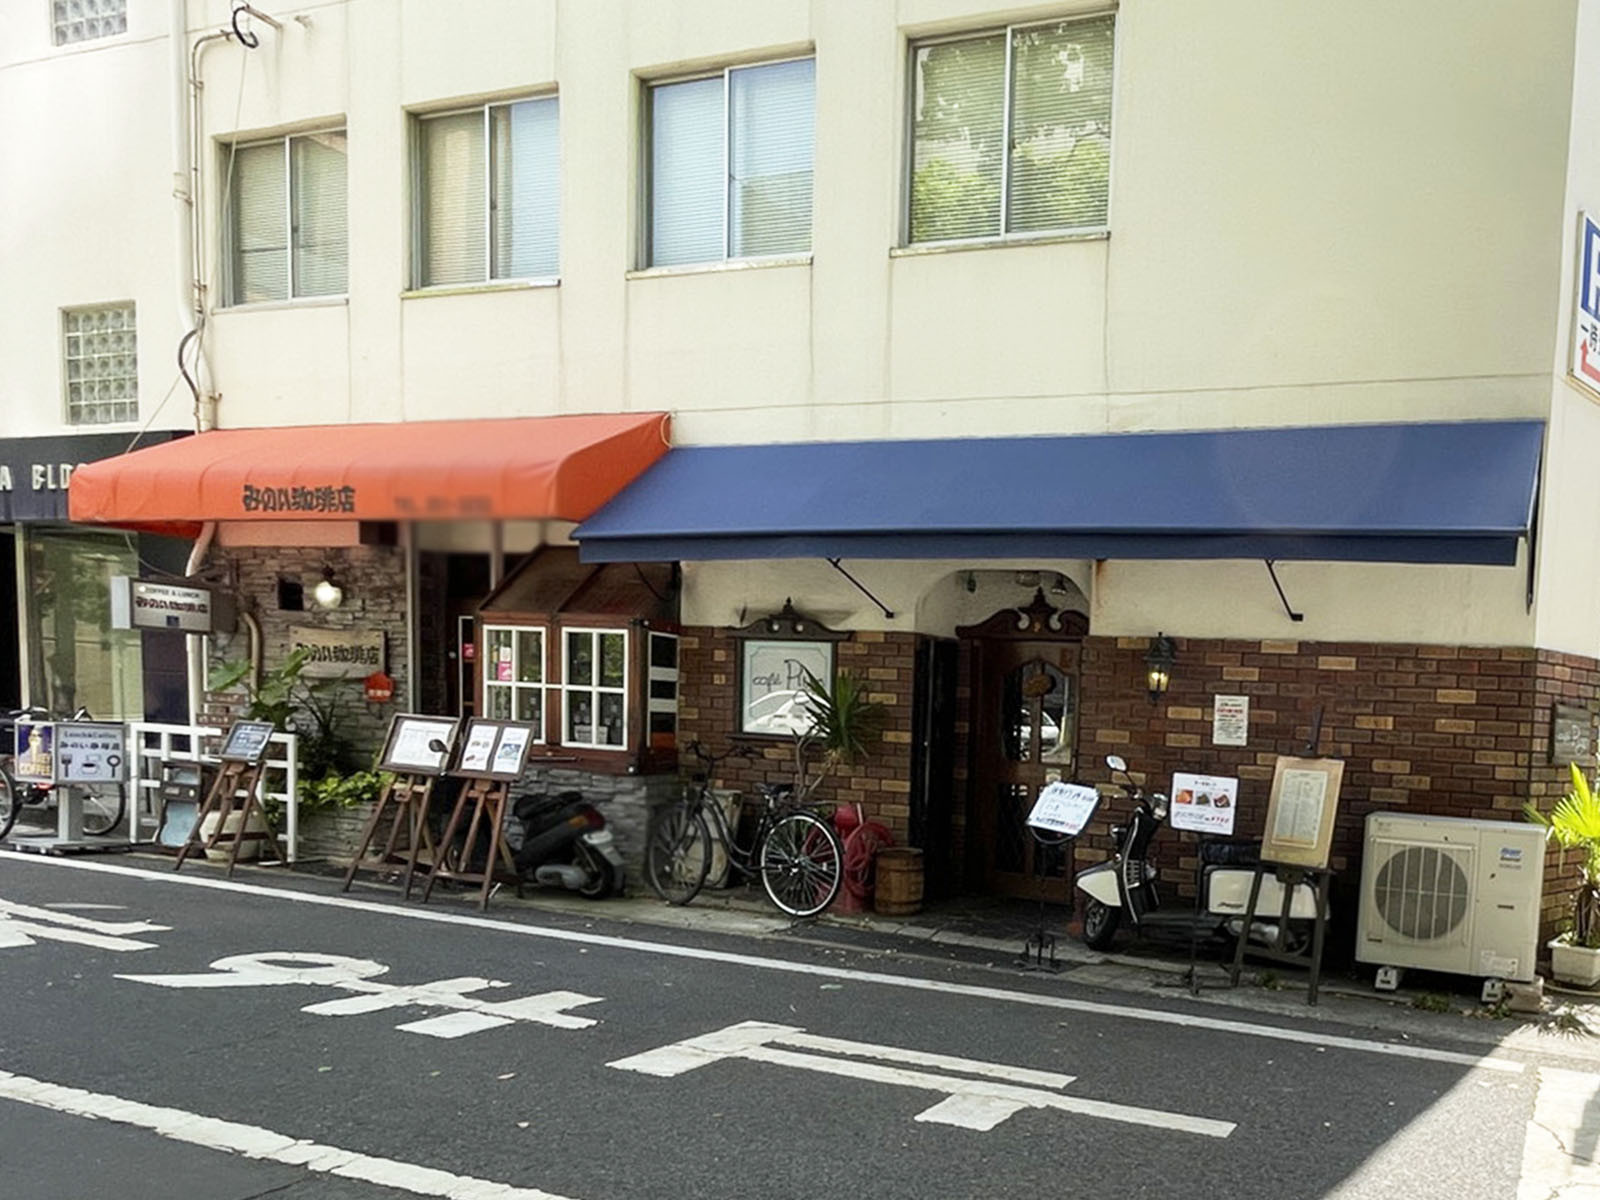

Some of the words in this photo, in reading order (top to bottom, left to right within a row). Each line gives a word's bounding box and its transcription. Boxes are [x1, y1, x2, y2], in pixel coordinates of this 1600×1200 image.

[32, 463, 88, 490] BLD
[243, 485, 355, 512] みのい珈琲店
